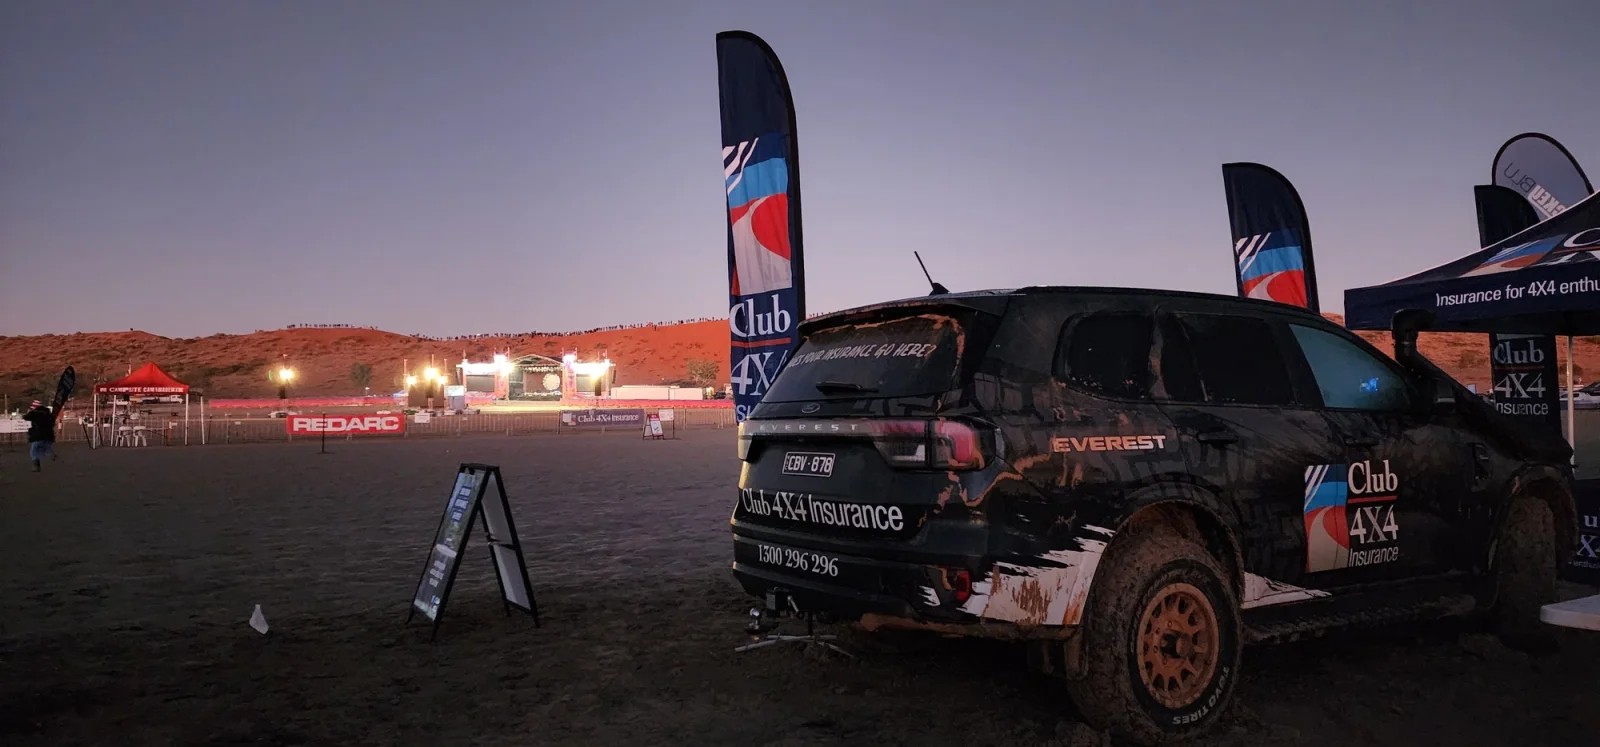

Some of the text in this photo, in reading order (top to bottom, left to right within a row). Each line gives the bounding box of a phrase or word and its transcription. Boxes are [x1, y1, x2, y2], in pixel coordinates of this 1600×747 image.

[1435, 289, 1502, 307] Insurance
[1505, 284, 1525, 300] for
[1527, 280, 1556, 297] 4X4
[730, 294, 791, 338] Club
[801, 349, 826, 365] YOUR
[821, 344, 876, 361] INSURANCE
[876, 344, 893, 359] GO
[892, 343, 937, 358] HERE?
[1493, 339, 1545, 365] Club
[1494, 372, 1547, 399] 4X4
[293, 416, 399, 432] REDARC
[577, 413, 639, 423] Club 4X4 Insurance
[1053, 435, 1166, 453] EVEREST
[1348, 460, 1398, 495] Club
[742, 488, 904, 531] Club 4X4 Insurance
[1350, 504, 1399, 544] 4X4
[758, 544, 839, 577] 1300 296 296
[1349, 546, 1399, 567] Insurance
[1172, 666, 1230, 725] TOYO TIRES
